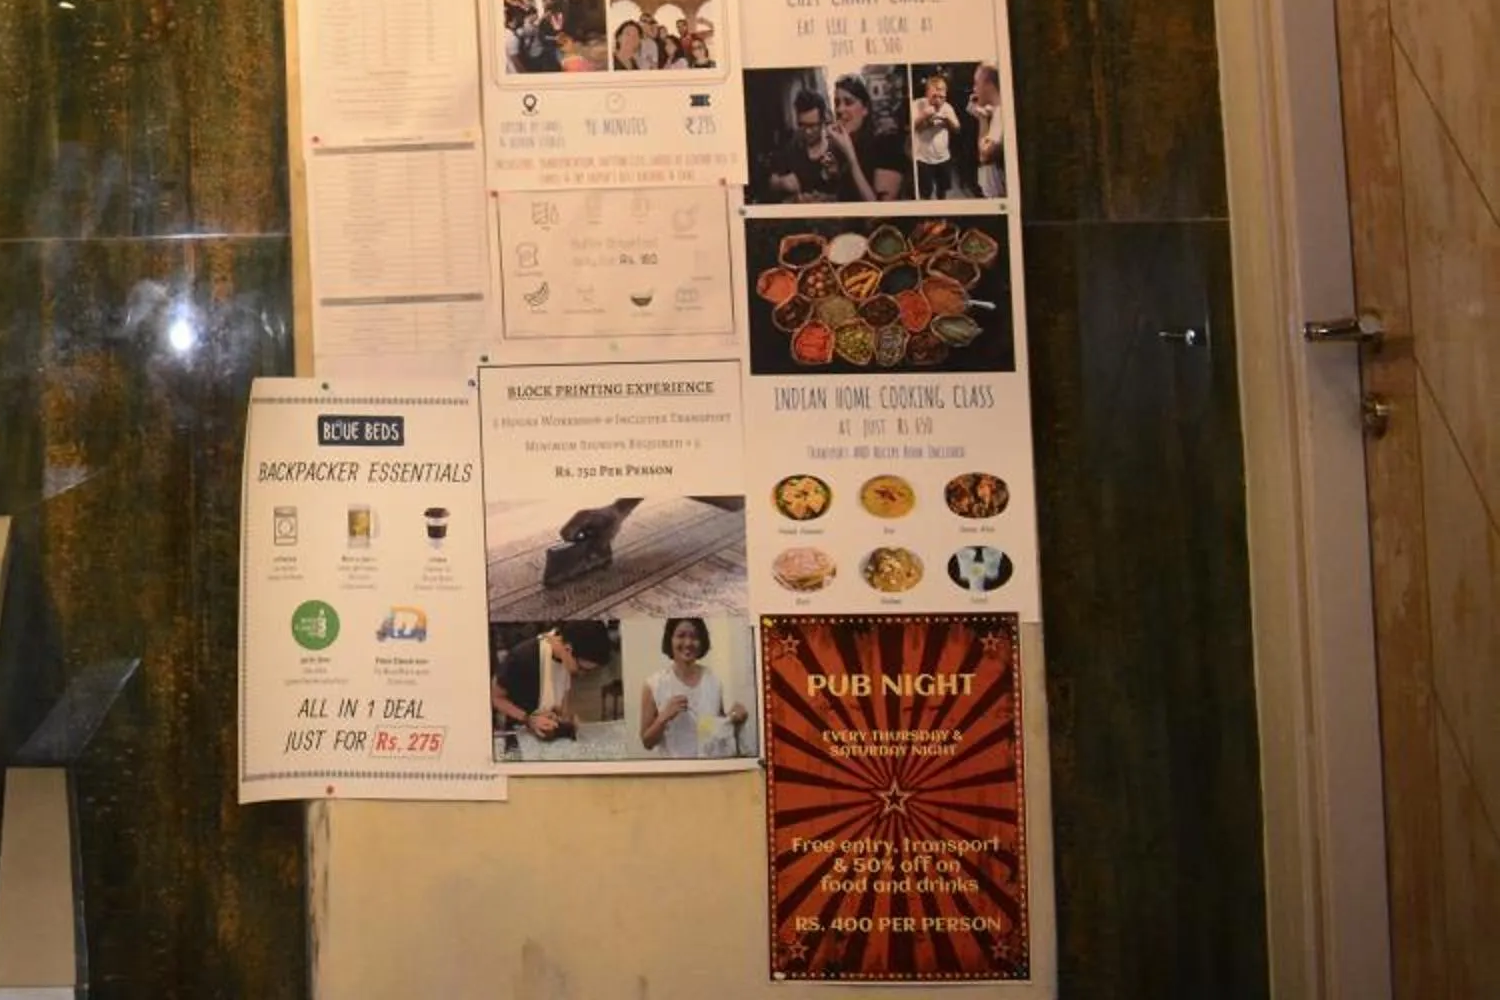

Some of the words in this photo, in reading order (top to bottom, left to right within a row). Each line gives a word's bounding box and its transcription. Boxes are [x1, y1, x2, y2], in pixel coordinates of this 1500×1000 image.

[508, 385, 552, 399] BLOCK
[555, 383, 624, 397] PRINTING
[626, 381, 715, 395] EXPERIENCE
[773, 387, 828, 411] INDIAN
[835, 386, 872, 410] HOME
[879, 385, 946, 409] COOKING
[953, 384, 995, 408] CLASS
[323, 421, 359, 440] BLUE
[365, 422, 399, 441] BEDS
[258, 461, 360, 482] BACKPACKER
[367, 462, 473, 483] ESSENTIALS
[807, 673, 872, 697] PUB
[882, 673, 976, 697] NIGHT
[297, 698, 329, 718] ALL
[337, 699, 359, 718] IN
[368, 699, 375, 718] 1
[383, 699, 425, 719] DEAL
[284, 730, 327, 753] JUST
[334, 731, 368, 751] FOR
[375, 732, 401, 751] Rs.
[407, 732, 442, 751] 275
[823, 730, 867, 742] EVERY
[872, 730, 949, 742] THURSDAY
[952, 730, 963, 741] &
[830, 745, 907, 758] SATURDAY
[911, 744, 958, 757] NIGHT
[792, 837, 835, 852] Free
[903, 837, 999, 857] transport
[833, 859, 848, 873] &
[853, 858, 895, 873] 50%
[900, 856, 932, 873] off
[936, 860, 961, 873] on
[820, 876, 867, 893] food
[873, 878, 912, 893] and
[916, 876, 979, 893] drinks
[795, 916, 825, 932] RS.
[830, 917, 873, 932] 400
[879, 917, 916, 932] PER
[921, 916, 1002, 932] PERSON
